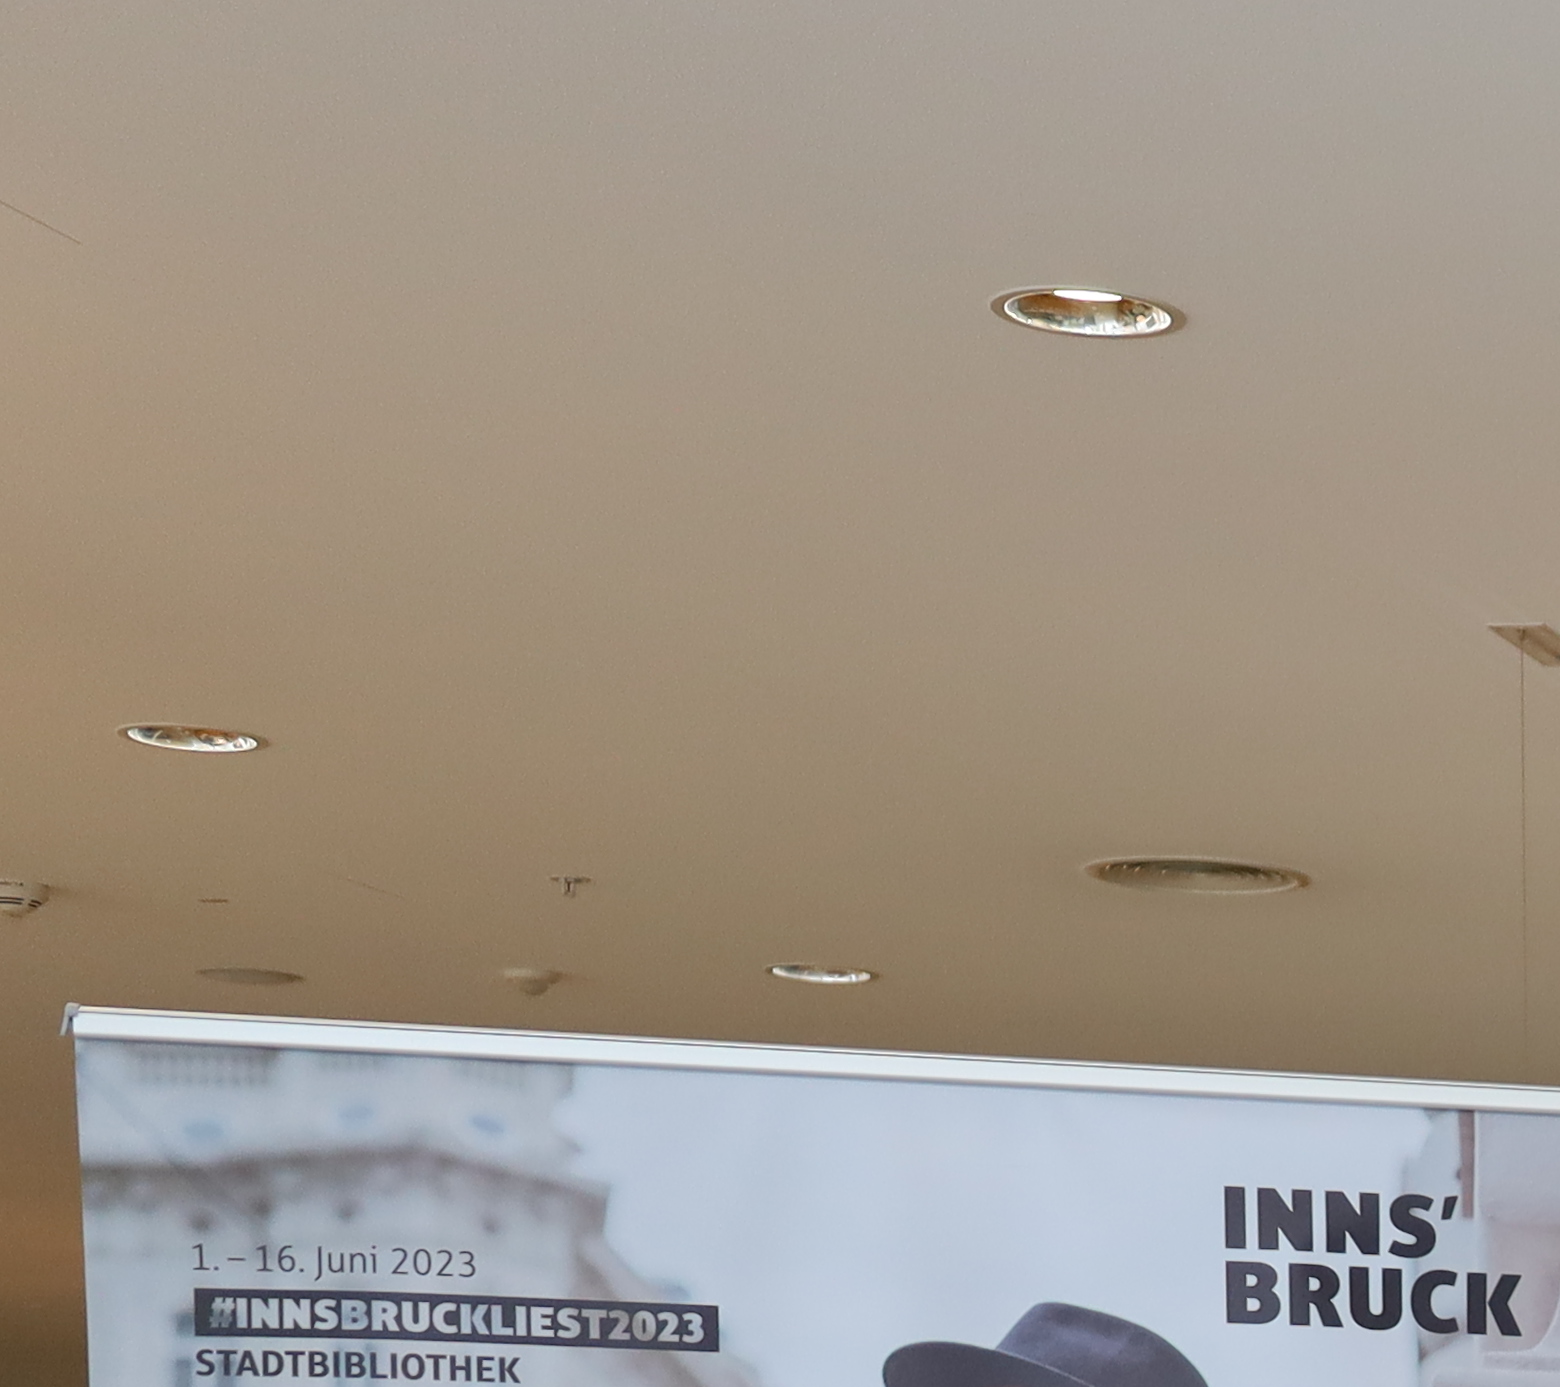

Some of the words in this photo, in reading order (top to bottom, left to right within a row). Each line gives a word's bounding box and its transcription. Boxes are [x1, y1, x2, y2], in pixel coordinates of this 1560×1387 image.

[192, 1243, 219, 1272] 1.
[256, 1244, 305, 1274] 16.
[313, 1244, 378, 1281] Juni
[391, 1247, 478, 1279] 2023
[207, 1295, 707, 1345] #INNSBRUCKLIEST2023
[1224, 1260, 1522, 1337] BRUCK
[195, 1350, 521, 1385] STADTBIBLIOTHEK
